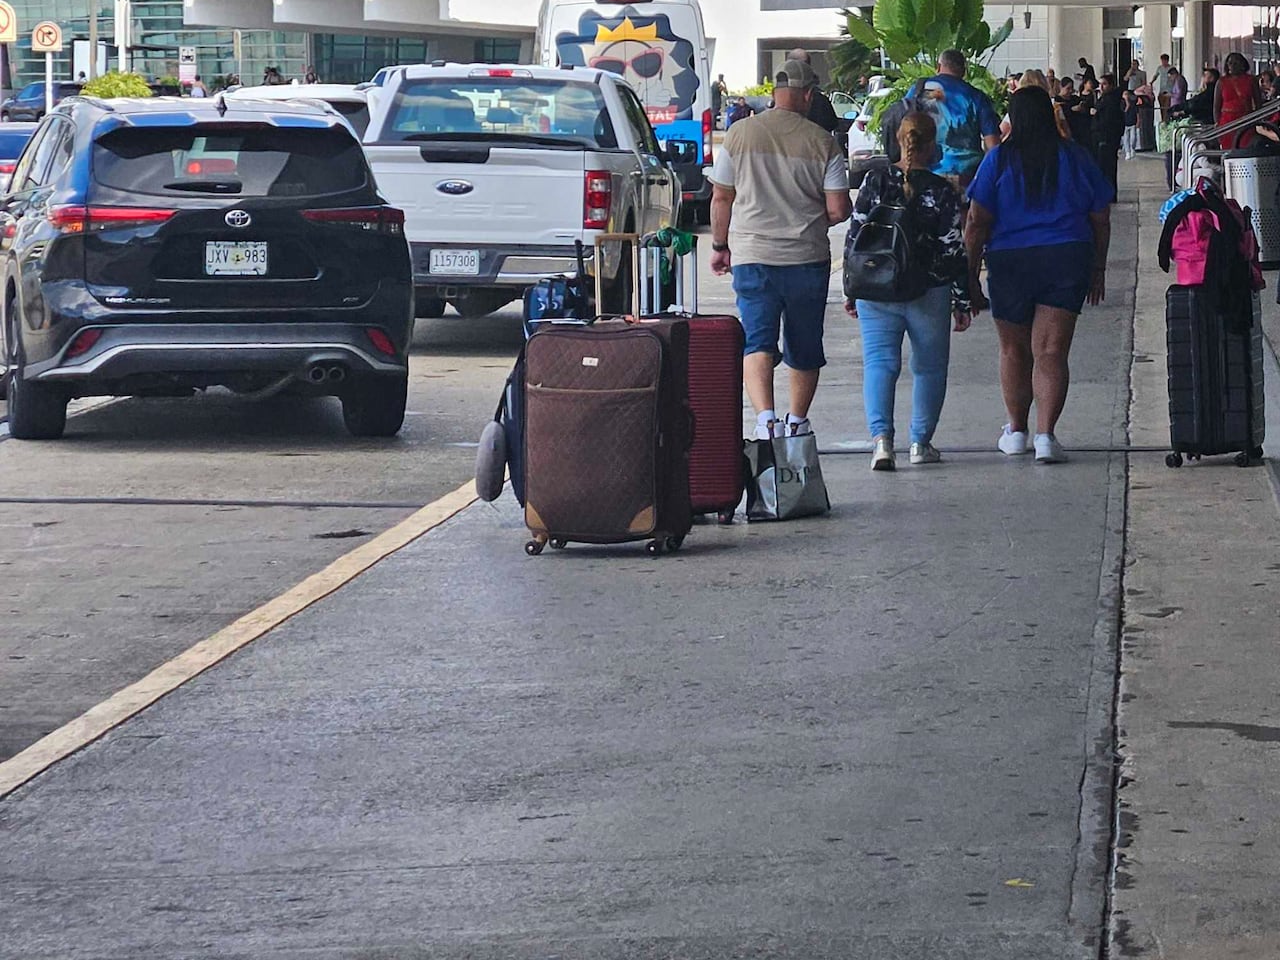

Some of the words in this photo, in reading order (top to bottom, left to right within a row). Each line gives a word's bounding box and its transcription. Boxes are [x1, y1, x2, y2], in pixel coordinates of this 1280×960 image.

[208, 249, 229, 264] JXV
[244, 249, 266, 263] 983
[434, 254, 476, 267] 1157308
